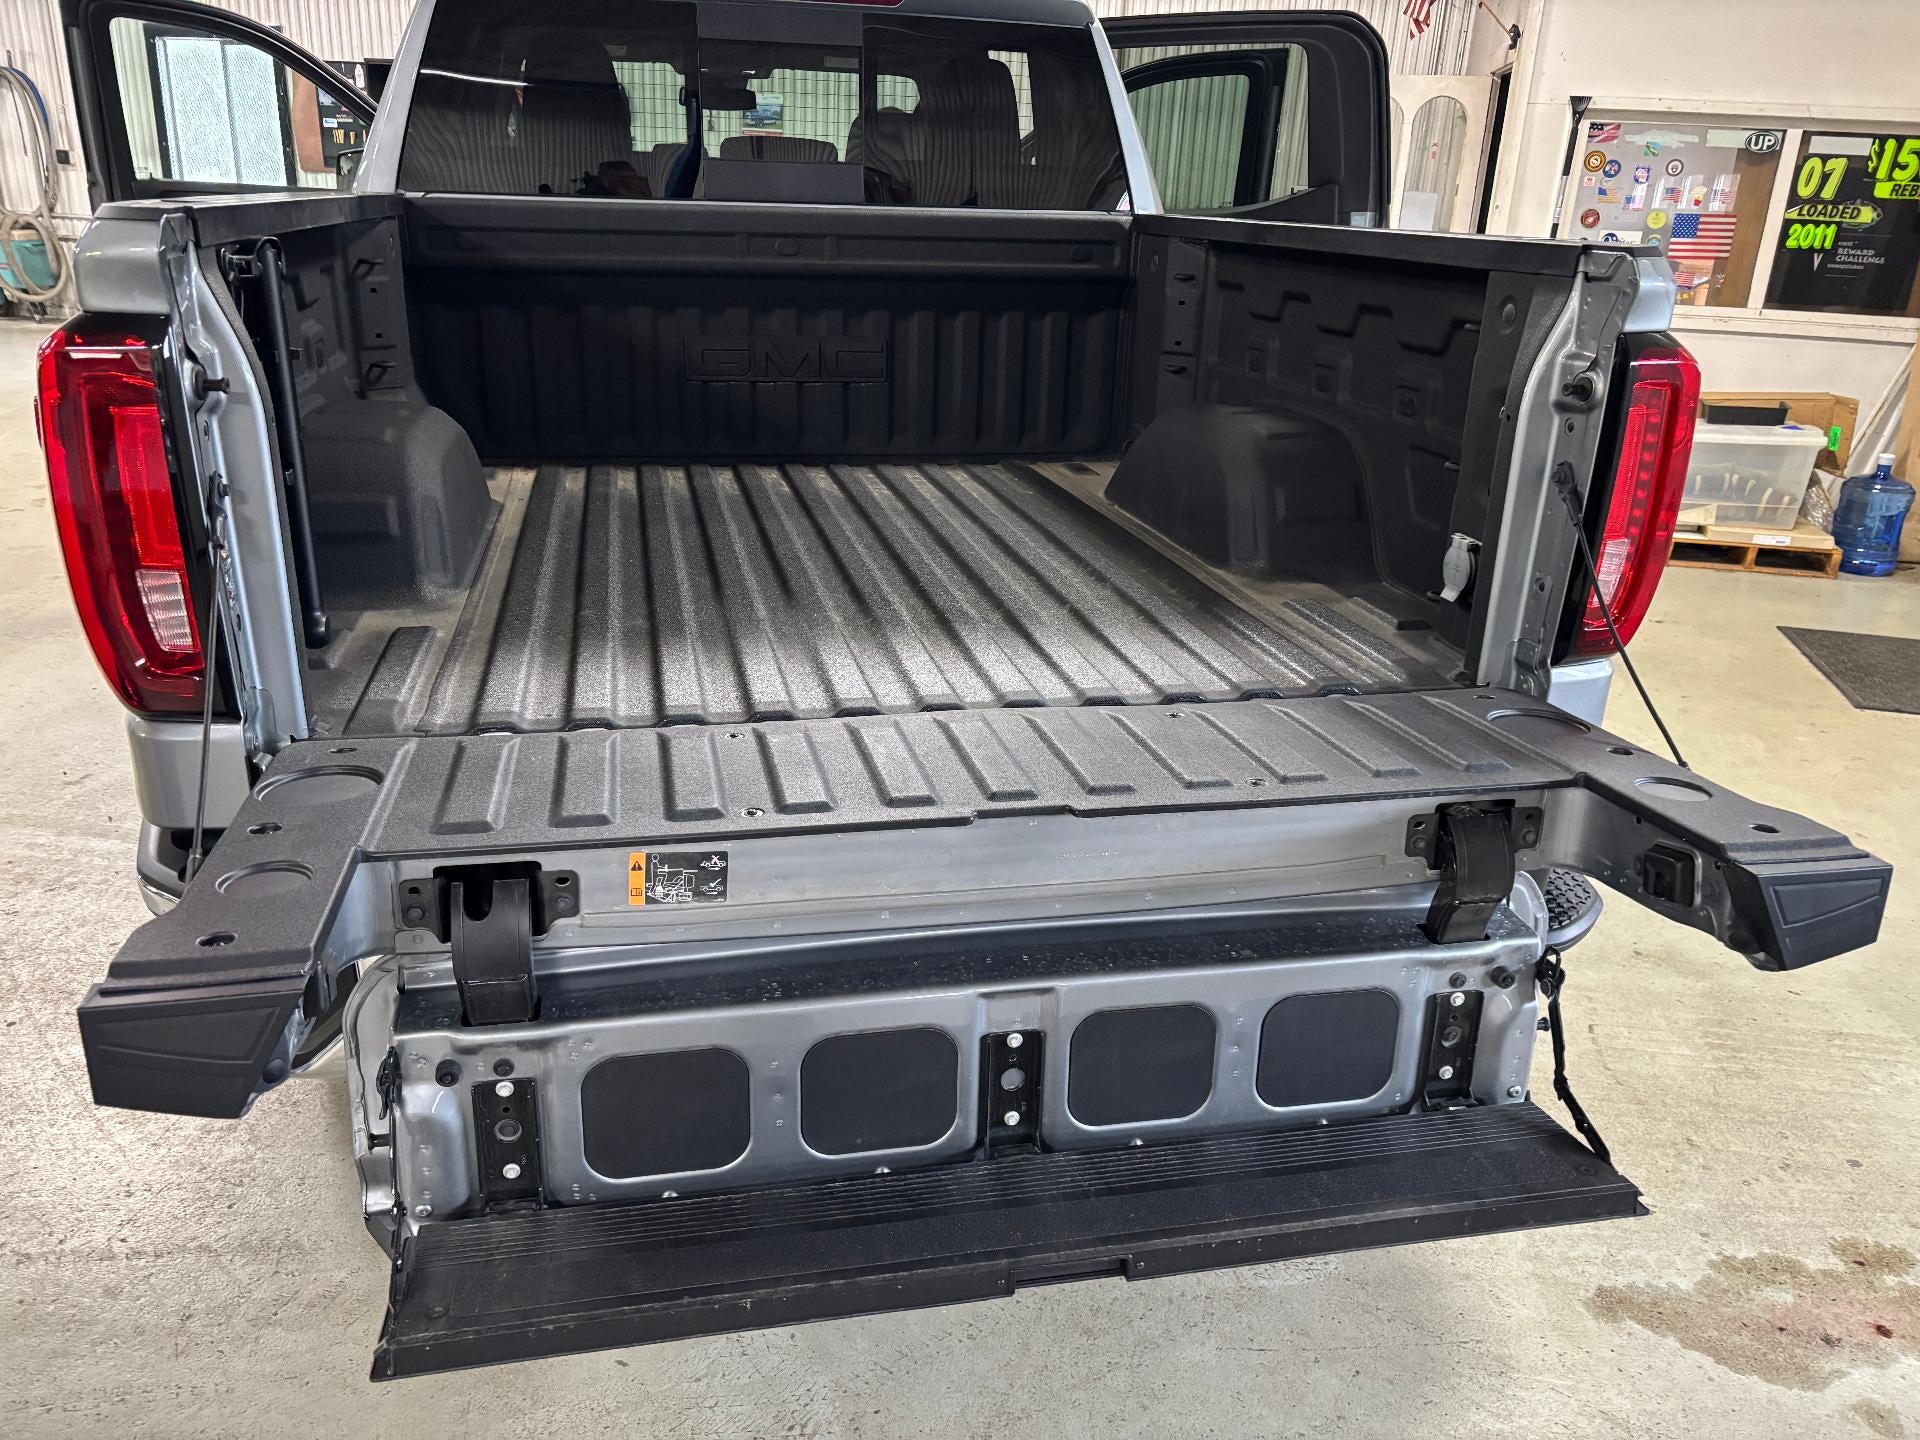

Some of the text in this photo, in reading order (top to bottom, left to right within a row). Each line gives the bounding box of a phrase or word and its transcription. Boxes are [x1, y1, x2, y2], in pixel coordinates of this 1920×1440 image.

[1750, 135, 1775, 151] UP
[1797, 157, 1849, 201] 07
[1797, 204, 1862, 220] LOADED
[1785, 223, 1838, 249] 2011
[1835, 255, 1887, 264] CHALLENGE
[1838, 247, 1876, 256] REWARD
[686, 340, 885, 379] GMC
